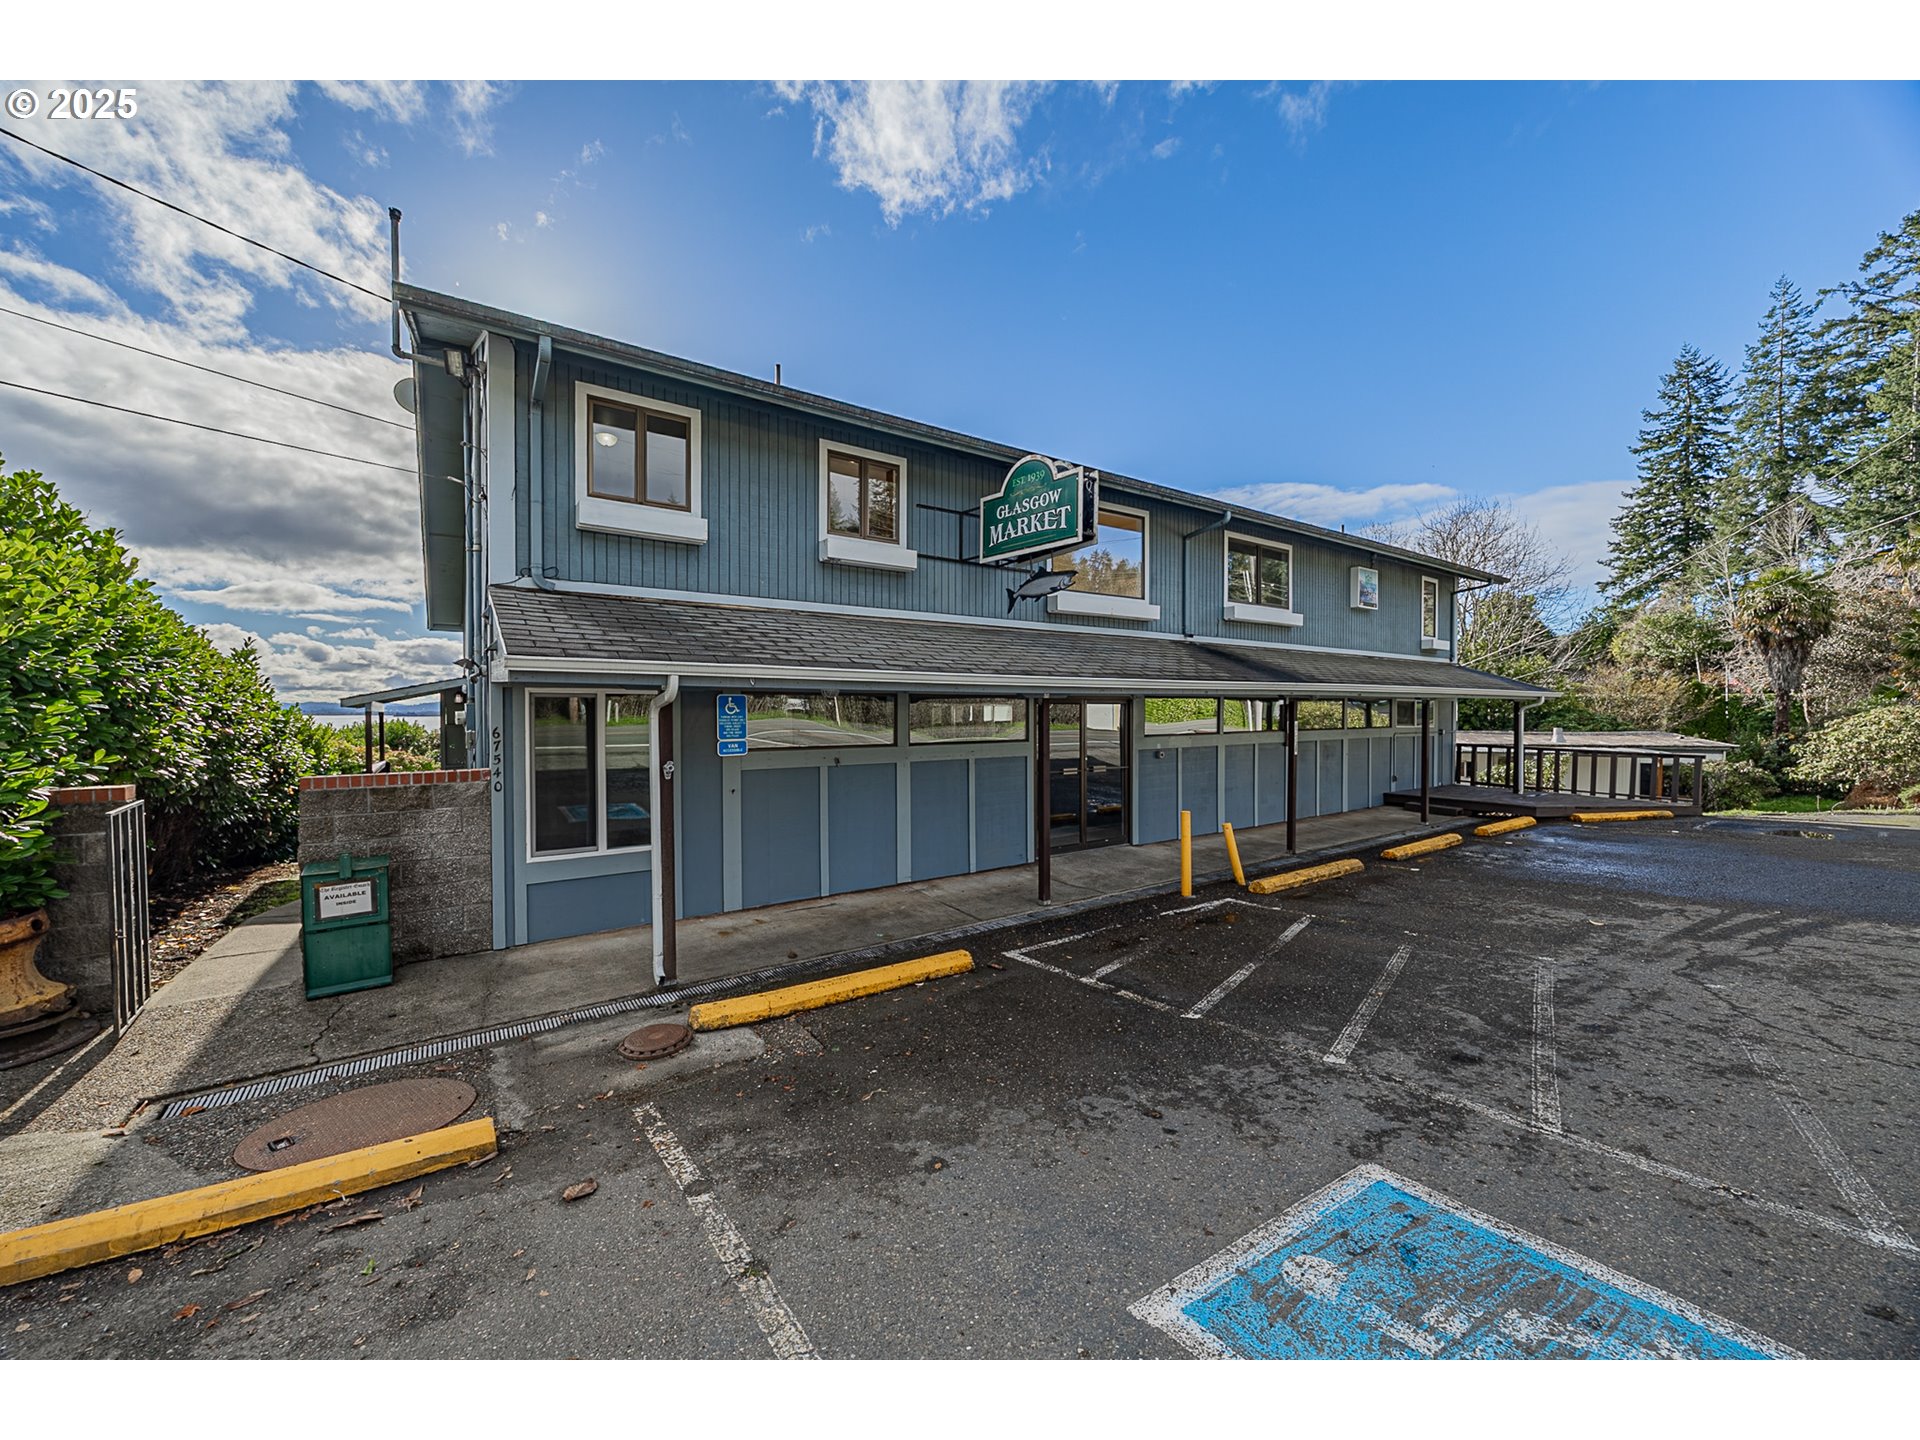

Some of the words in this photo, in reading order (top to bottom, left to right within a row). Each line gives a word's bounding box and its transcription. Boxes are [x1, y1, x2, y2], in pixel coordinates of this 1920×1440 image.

[1027, 469, 1046, 484] 1939
[996, 488, 1063, 520] GLASGOW
[988, 505, 1072, 548] MARKET
[492, 726, 503, 792] 67540
[324, 890, 367, 901] AVAILABLE
